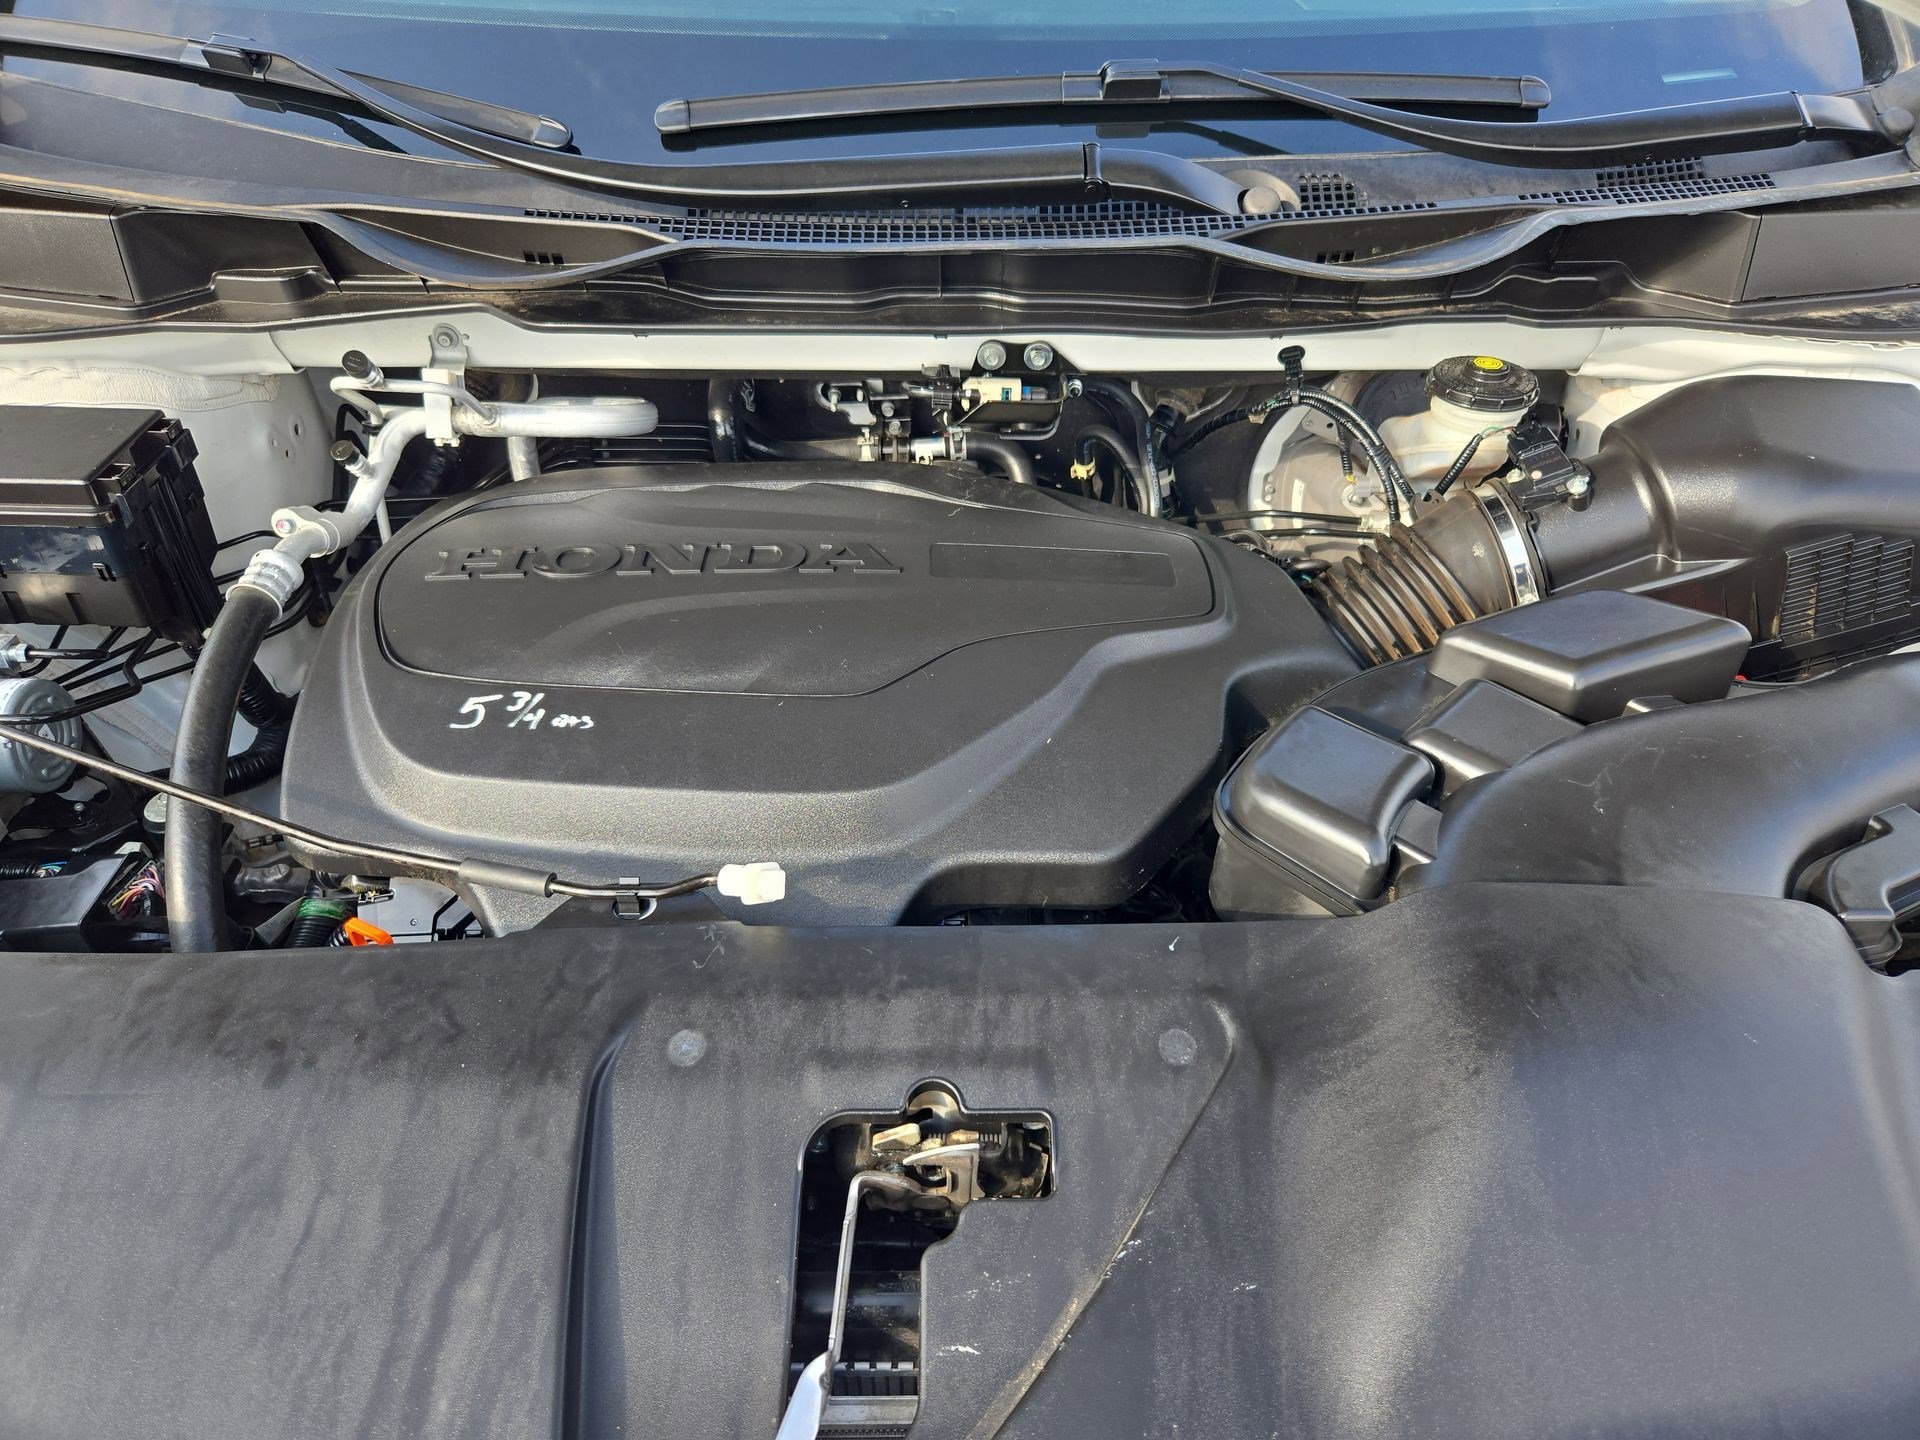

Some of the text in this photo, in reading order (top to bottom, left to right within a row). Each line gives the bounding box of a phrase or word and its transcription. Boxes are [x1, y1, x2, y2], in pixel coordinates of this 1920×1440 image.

[424, 543, 904, 580] HONDA
[449, 694, 504, 729] 5
[506, 691, 546, 730] 3/4
